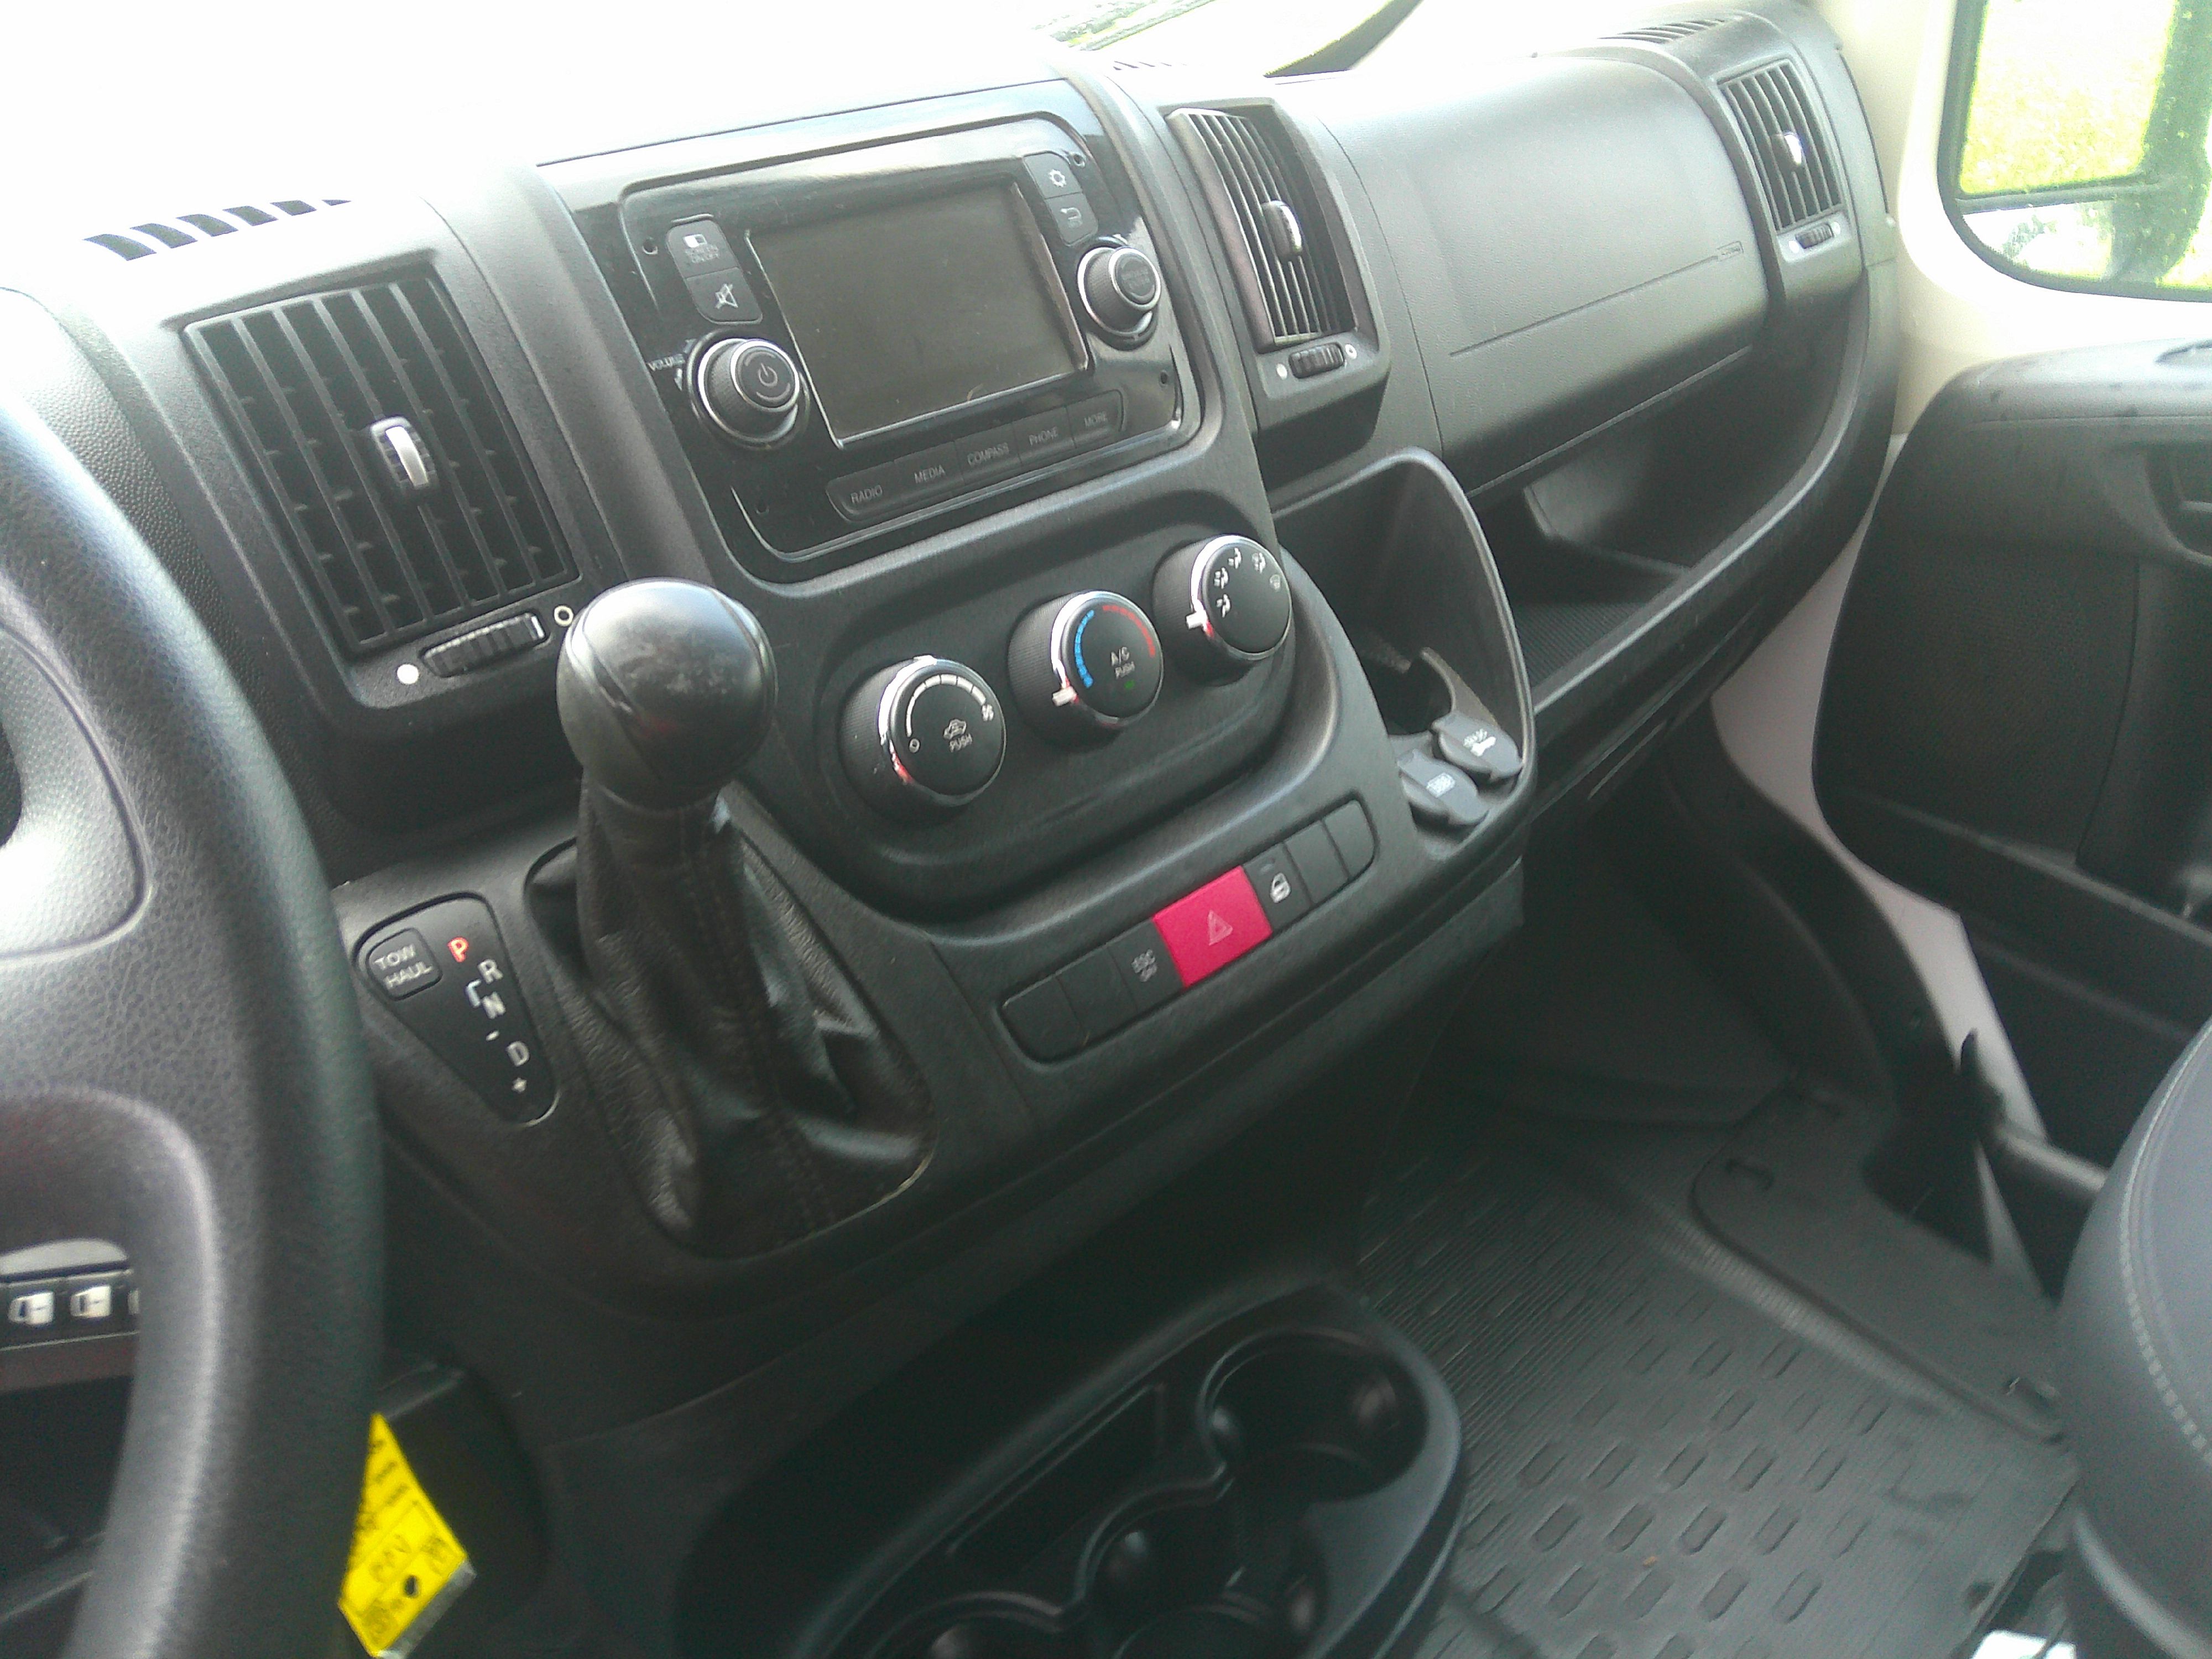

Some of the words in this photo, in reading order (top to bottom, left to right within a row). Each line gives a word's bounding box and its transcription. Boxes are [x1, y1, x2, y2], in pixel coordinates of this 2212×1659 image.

[1084, 411, 1108, 427] MORE
[1029, 426, 1058, 446] PHONE
[968, 442, 1009, 466] COMPASS
[914, 465, 946, 484] MEDIA
[851, 484, 883, 504] RADIO
[1110, 646, 1130, 666] A/C
[374, 943, 416, 971] TOW
[447, 936, 469, 963] P
[383, 961, 433, 988] HAUL
[477, 959, 504, 984] R
[482, 992, 506, 1019] N
[506, 1041, 530, 1067] D
